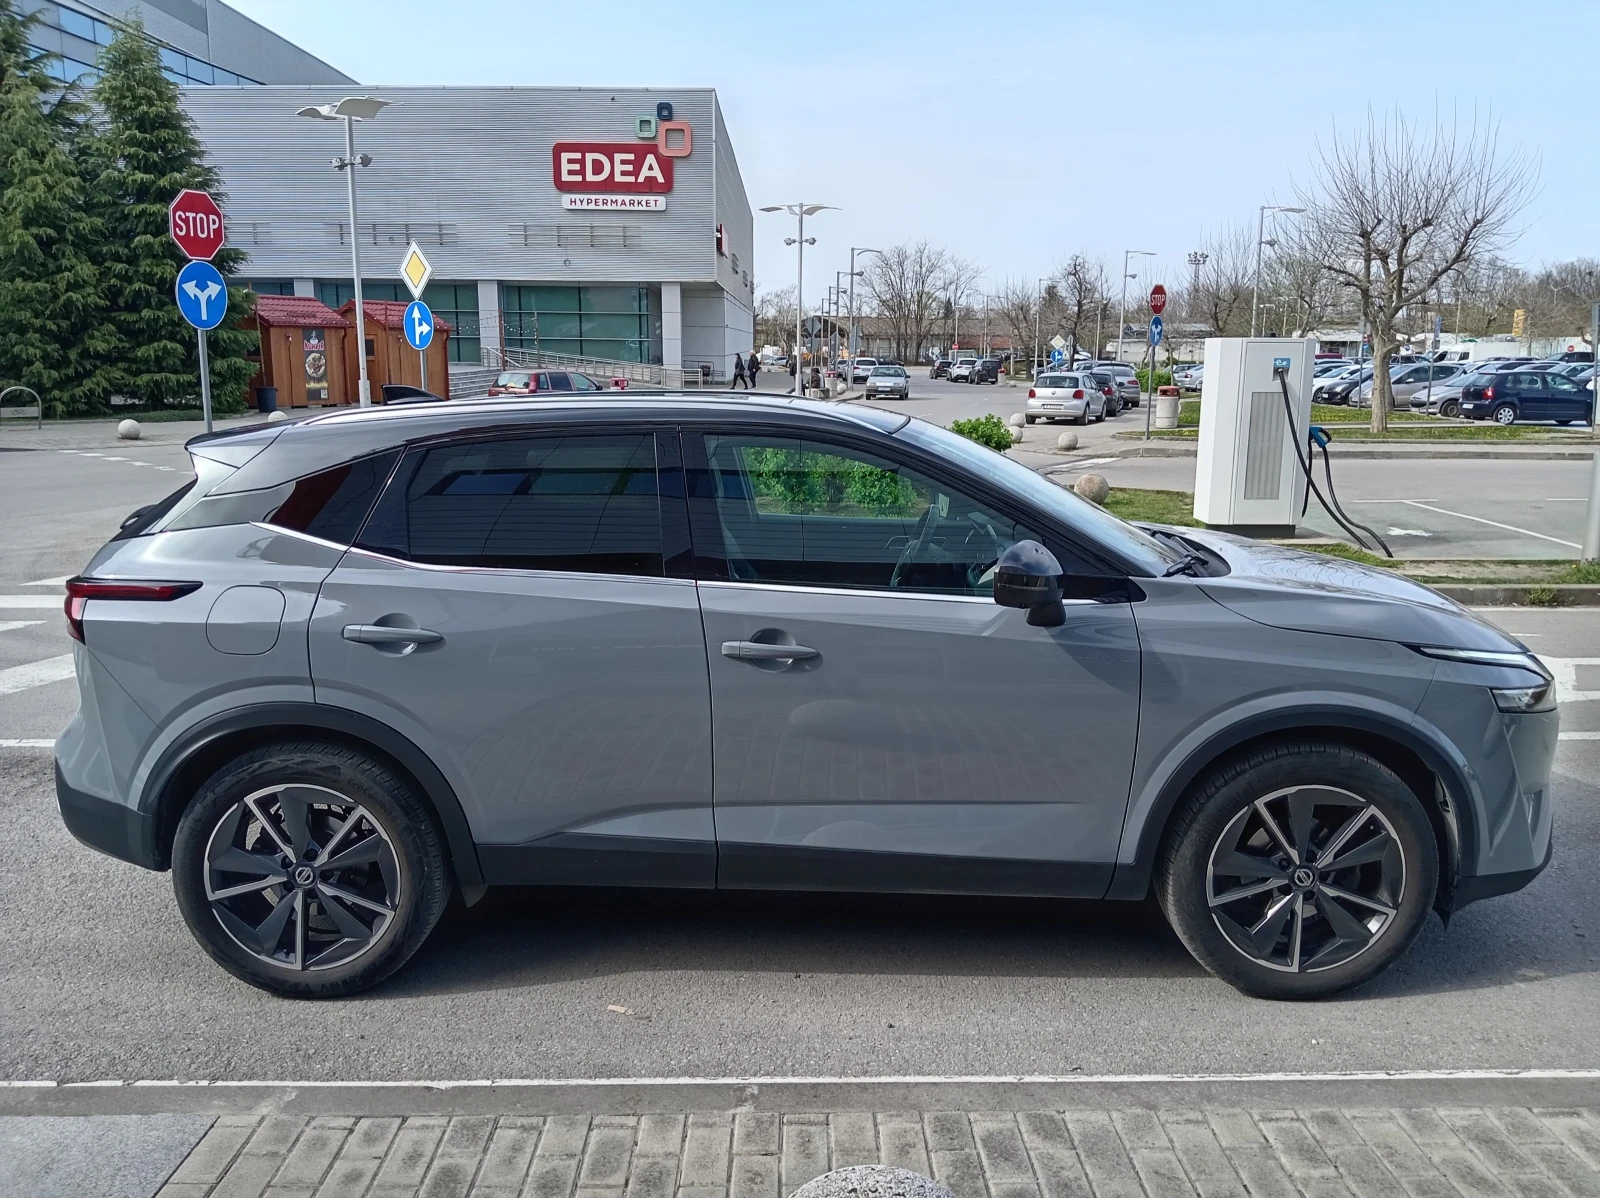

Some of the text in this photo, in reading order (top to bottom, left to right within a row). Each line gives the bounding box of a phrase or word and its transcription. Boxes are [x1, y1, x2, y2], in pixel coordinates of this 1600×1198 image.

[560, 152, 665, 183] EDEA
[569, 197, 659, 208] HYPERMARKET
[175, 210, 220, 239] STOP
[1151, 294, 1165, 306] STOP
